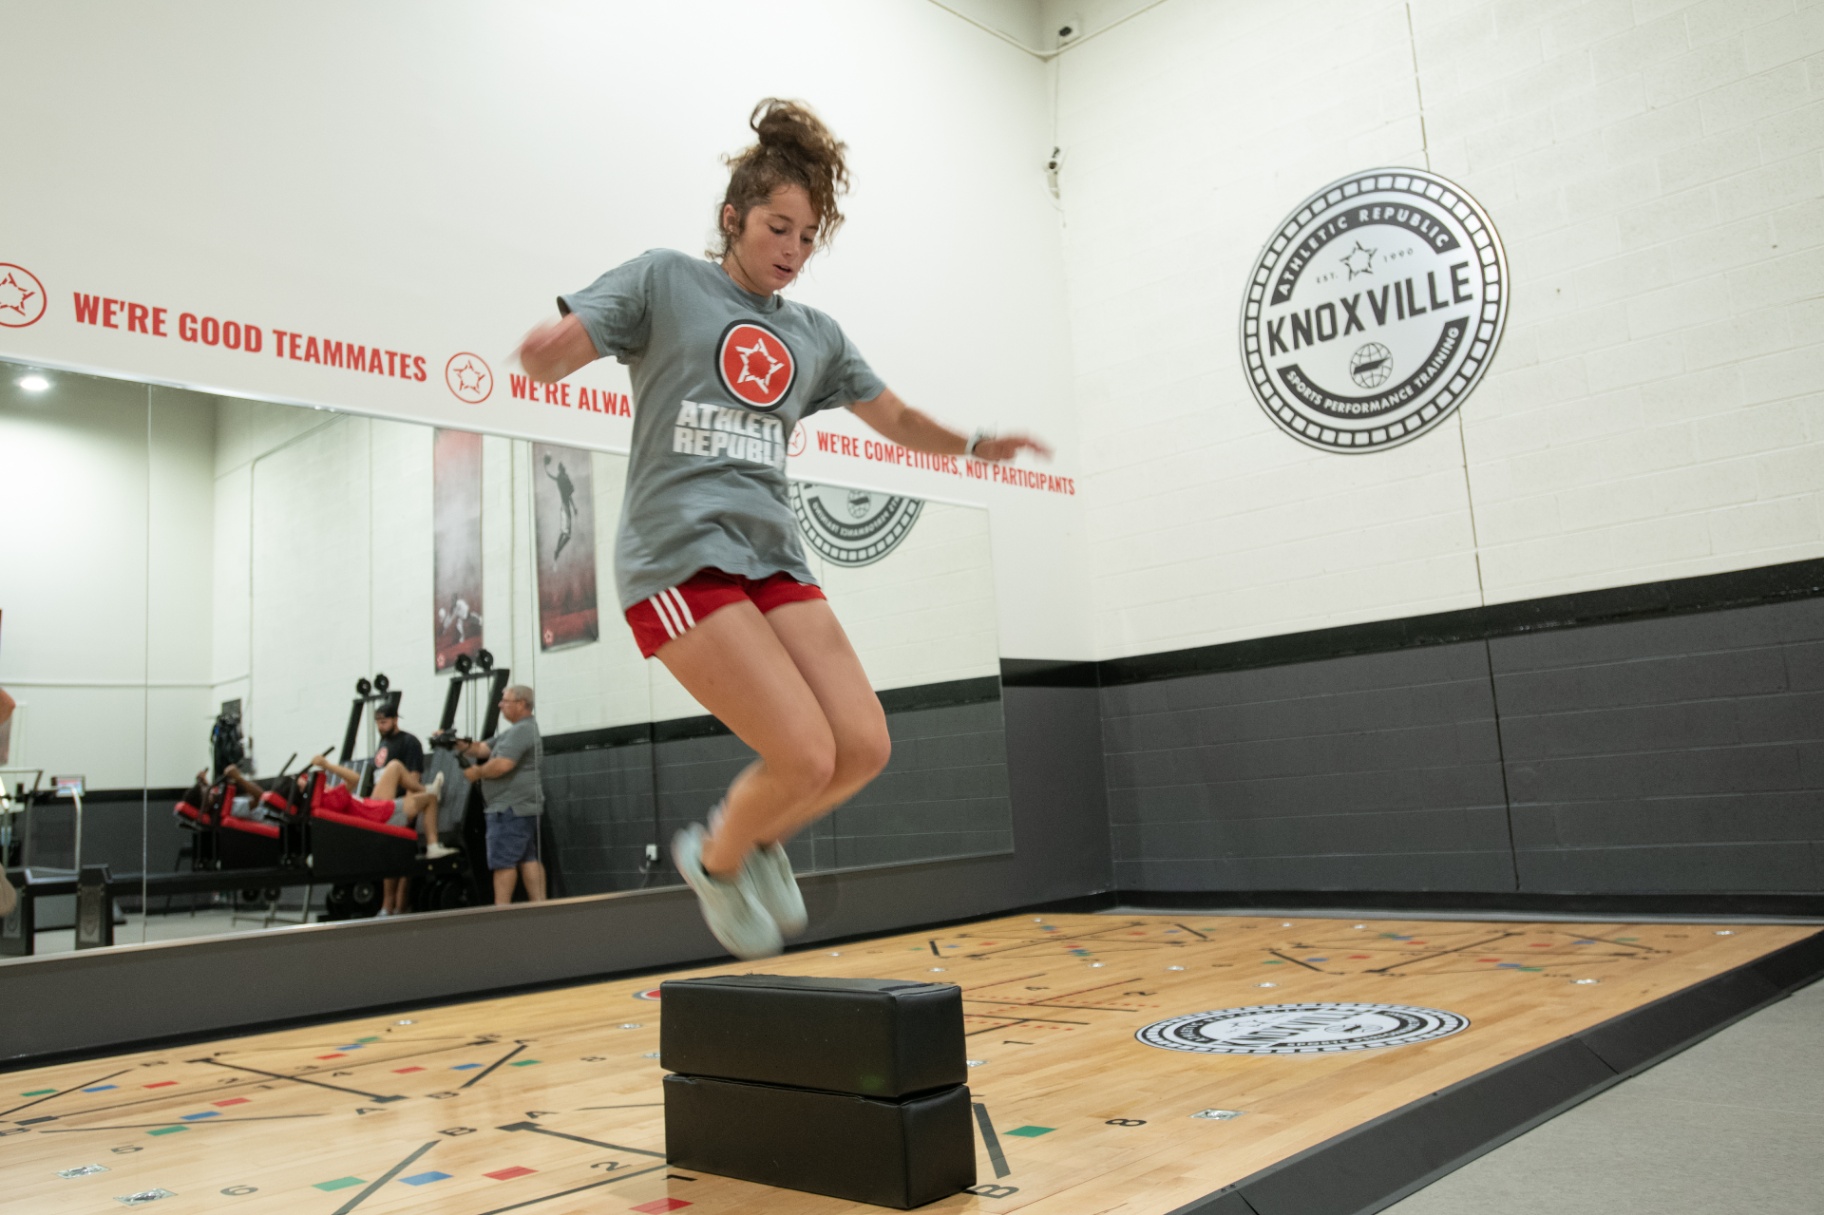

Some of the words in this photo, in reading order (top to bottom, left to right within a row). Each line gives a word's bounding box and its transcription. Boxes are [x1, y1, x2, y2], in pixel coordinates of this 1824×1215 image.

[1277, 217, 1349, 296] ATHLETIC
[1358, 206, 1450, 249] REPUBLIC
[1267, 260, 1474, 358] KNOXVILLE
[73, 291, 168, 337] WE'RE
[178, 311, 263, 353] GOOD
[272, 329, 427, 383] TEAMMATES
[1286, 370, 1322, 405] SPORTS
[1323, 386, 1415, 414] PERFORMANCE
[1415, 326, 1460, 388] TRAINING
[510, 373, 570, 408] WE'RE
[578, 386, 632, 418] ALWA
[675, 399, 784, 445] ATHLETI
[672, 426, 785, 473] REPUBLI
[816, 430, 860, 458] WE'RE
[864, 440, 963, 478] COMPETITORS,
[965, 458, 989, 480] NOT
[993, 463, 1075, 496] PARTICIPANTS
[1105, 1118, 1148, 1127] 8
[590, 1161, 631, 1172] 2
[220, 1185, 259, 1196] 6
[965, 1183, 1020, 1199] B
